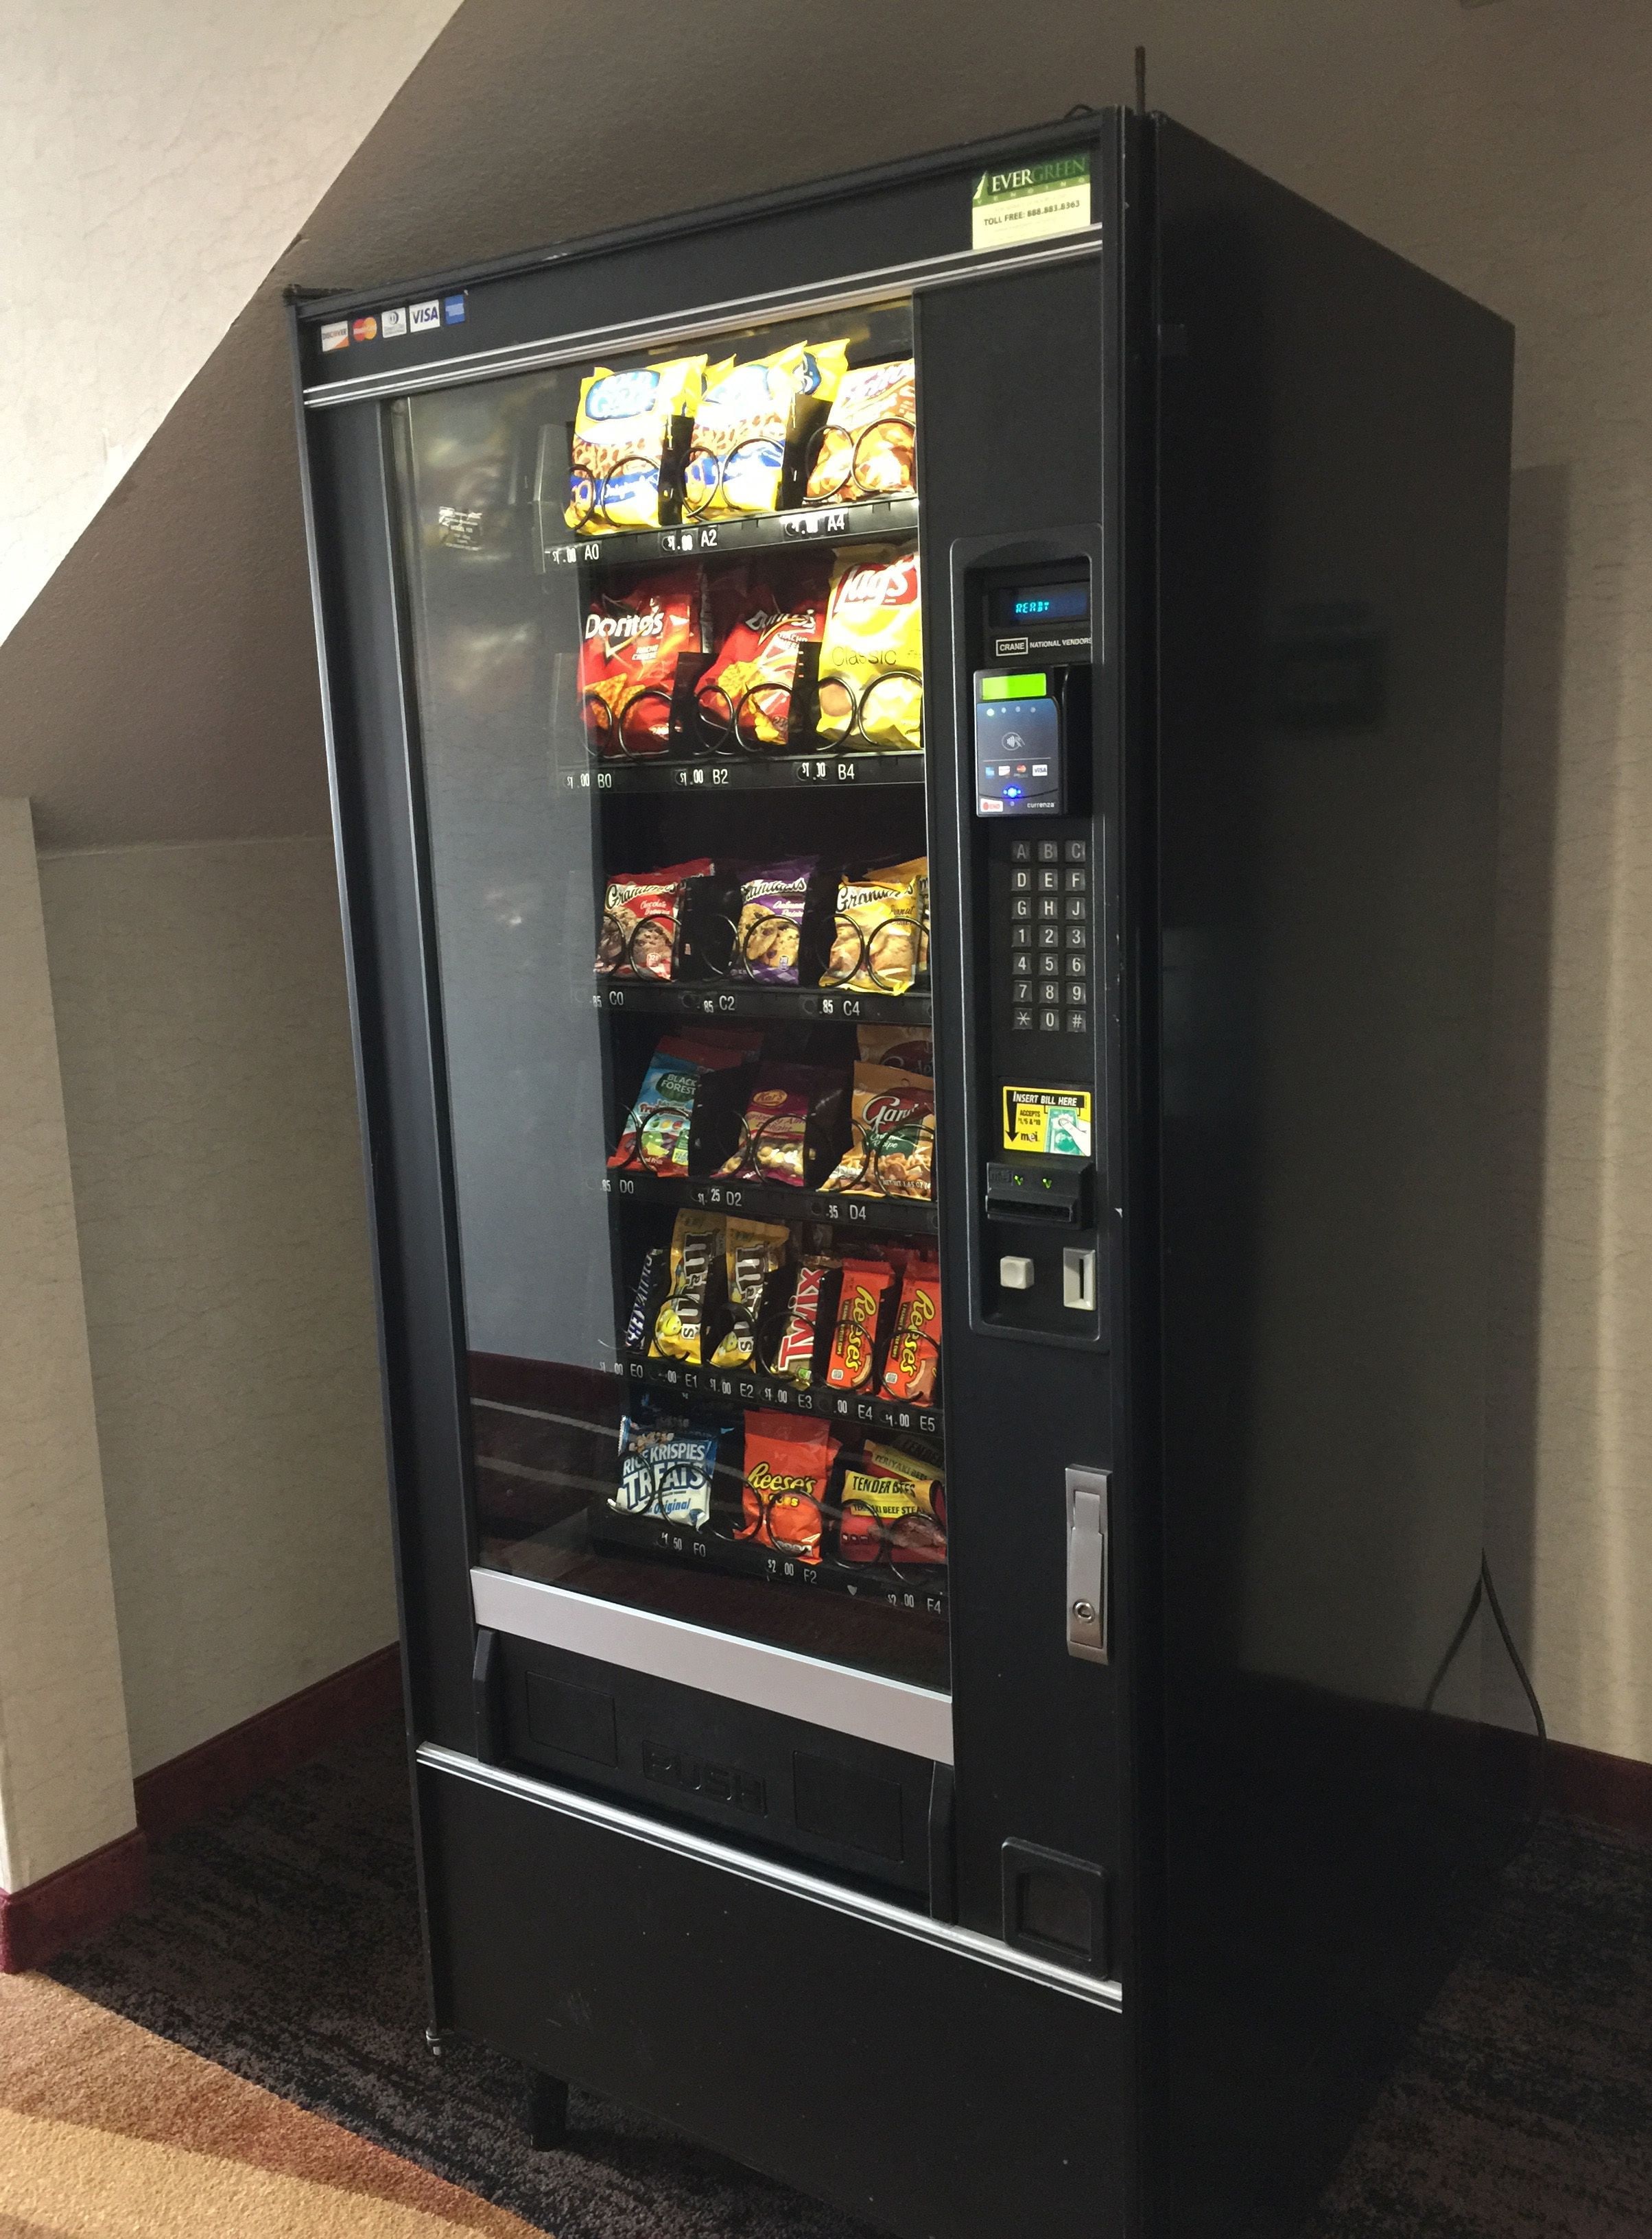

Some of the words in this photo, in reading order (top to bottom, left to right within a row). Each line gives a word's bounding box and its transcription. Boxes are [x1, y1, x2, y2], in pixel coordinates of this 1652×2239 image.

[993, 158, 1086, 192] EVERGREEN
[984, 217, 1002, 226] TOLL
[1004, 211, 1025, 222] FREE:
[412, 306, 439, 324] VISA
[827, 514, 845, 532] A4
[701, 529, 718, 547] A2
[585, 613, 664, 639] Doritos
[1000, 642, 1025, 652] CRANE
[1030, 639, 1061, 648] NATIONAL
[1062, 637, 1092, 646] VENDORS
[831, 646, 897, 667] Classic
[713, 769, 729, 784] B2
[838, 763, 855, 780] B4
[598, 773, 612, 788] B0
[1017, 844, 1026, 859] A
[1044, 844, 1053, 859] B
[1071, 843, 1081, 858] C
[1017, 873, 1026, 887] D
[1045, 873, 1053, 887] E
[1072, 873, 1081, 888] F
[1017, 901, 1026, 916] G
[1044, 901, 1054, 916] H
[1072, 901, 1080, 916] J
[1019, 929, 1025, 943] 1
[1045, 929, 1054, 943] 2
[1072, 929, 1081, 944] 3
[1018, 956, 1026, 971] 4
[1046, 956, 1054, 971] 5
[1072, 958, 1081, 972] 6
[1019, 984, 1027, 999] 7
[1046, 985, 1054, 999] 8
[1072, 986, 1081, 1000] 9
[719, 995, 735, 1010] C2
[843, 1000, 860, 1016] C4
[661, 1080, 696, 1095] FOREST
[667, 1074, 697, 1087] BLACK
[1013, 1091, 1039, 1103] INSERT
[1041, 1095, 1056, 1104] BILL
[1059, 1097, 1077, 1106] HERE
[1020, 1131, 1038, 1142] mei
[727, 1192, 742, 1206] D2
[850, 1205, 866, 1220] D4
[900, 1289, 935, 1377] Reese's
[686, 1374, 698, 1388] E1
[740, 1383, 754, 1398] E2
[799, 1394, 812, 1409] E3
[858, 1405, 873, 1421] E4
[920, 1416, 935, 1432] E5
[650, 1443, 705, 1463] KRISPIES
[875, 1454, 910, 1475] TERIYAKI
[624, 1461, 704, 1508] TREATS
[748, 1463, 816, 1494] Reese's
[853, 1476, 890, 1494] TENDER
[654, 1498, 692, 1515] Oiginal
[883, 1505, 901, 1515] BEEF
[803, 1569, 817, 1585] F2
[927, 1598, 941, 1614] F4
